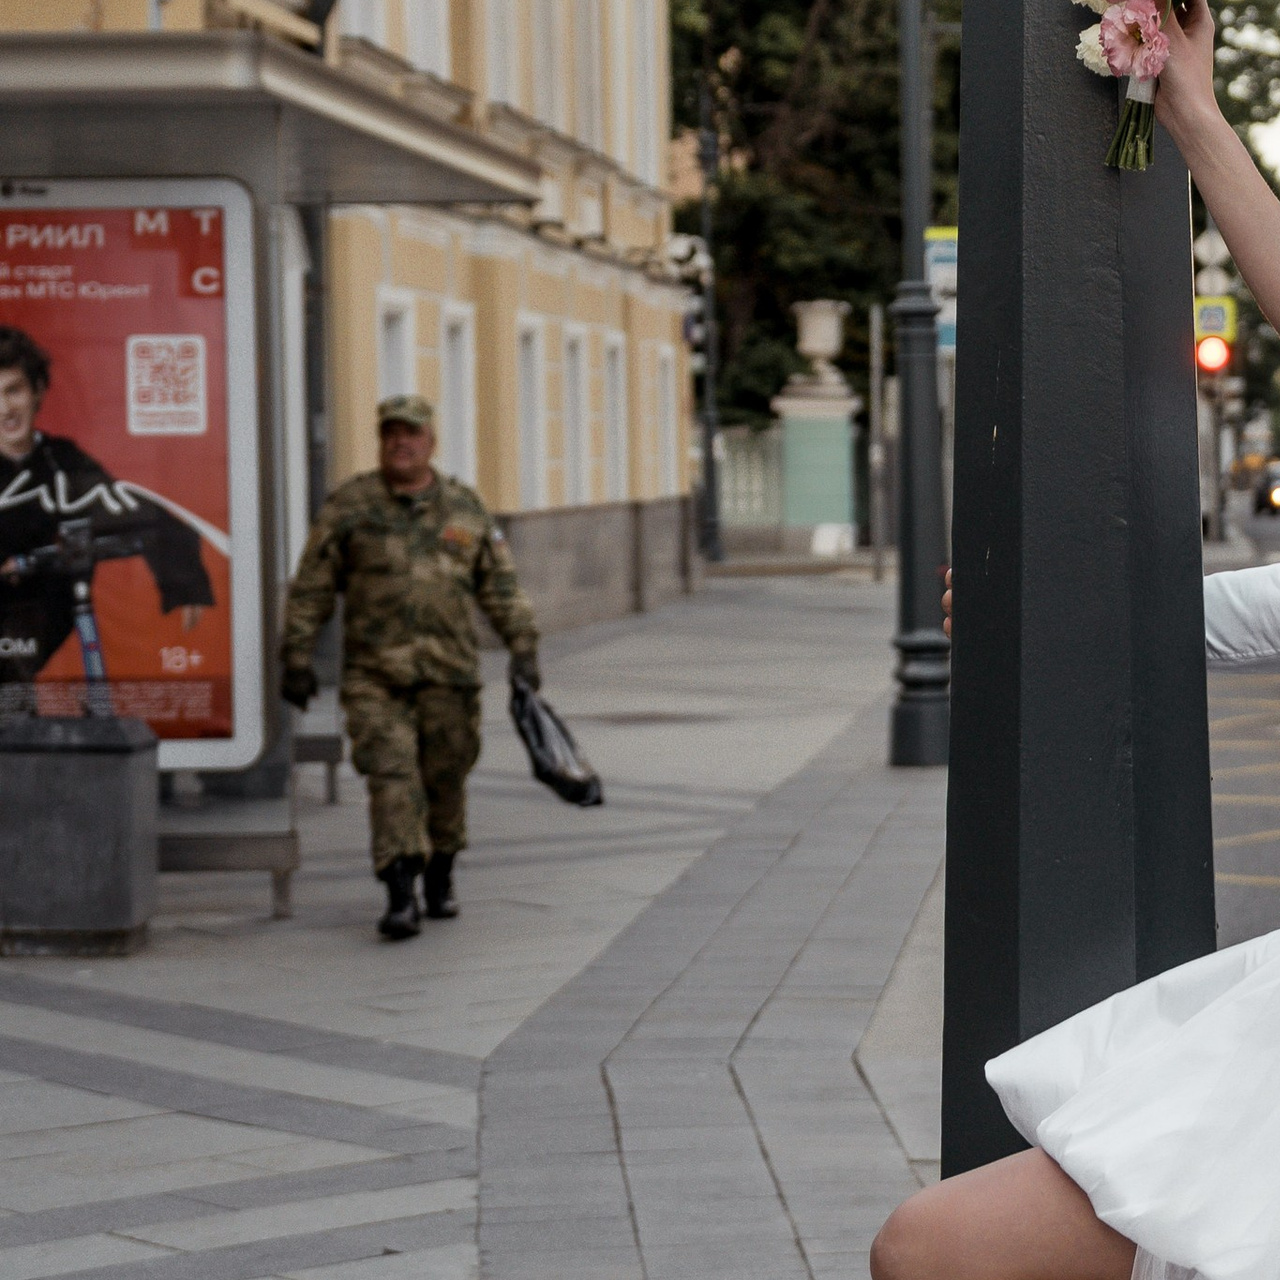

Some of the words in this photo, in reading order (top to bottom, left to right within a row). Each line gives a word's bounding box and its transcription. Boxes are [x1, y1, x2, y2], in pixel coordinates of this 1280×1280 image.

[6, 223, 104, 249] РИИЛ
[134, 210, 169, 236] М
[190, 208, 217, 237] Т
[191, 266, 220, 295] С
[160, 646, 202, 672] 18+
